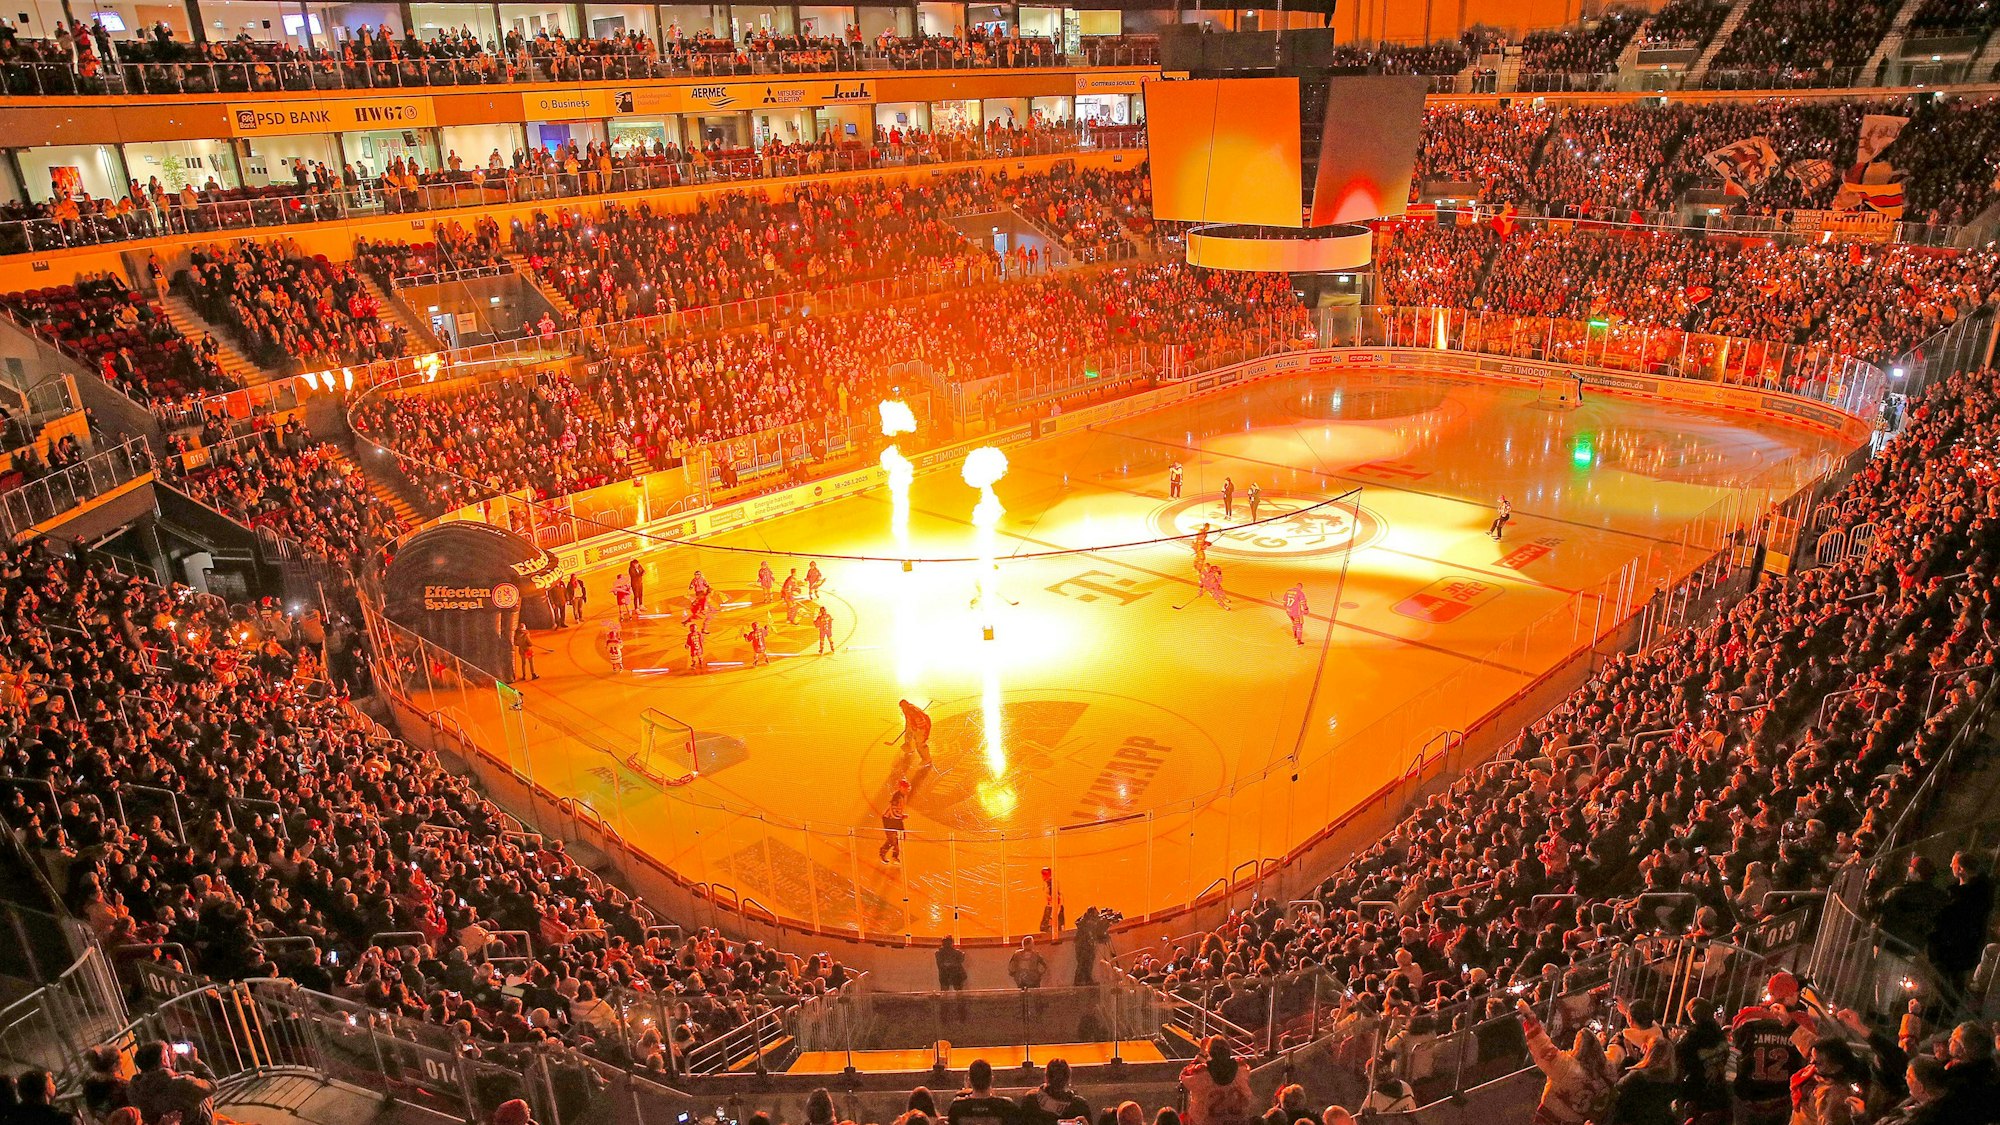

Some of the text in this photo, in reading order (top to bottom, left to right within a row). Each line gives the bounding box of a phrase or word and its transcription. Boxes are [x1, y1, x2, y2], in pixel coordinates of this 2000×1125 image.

[691, 87, 727, 99] AERMEC
[552, 98, 590, 109] Business
[257, 110, 331, 125] PSD BANK
[354, 106, 402, 122] HW67
[1514, 366, 1552, 378] TIMOCOM
[935, 446, 970, 463] TIMOCOM
[602, 541, 633, 555] MERKUR
[424, 586, 491, 599] Effecten
[424, 598, 484, 611] Spiegel
[1765, 921, 1796, 948] 013
[149, 972, 180, 998] 014
[1752, 1047, 1789, 1081] 12
